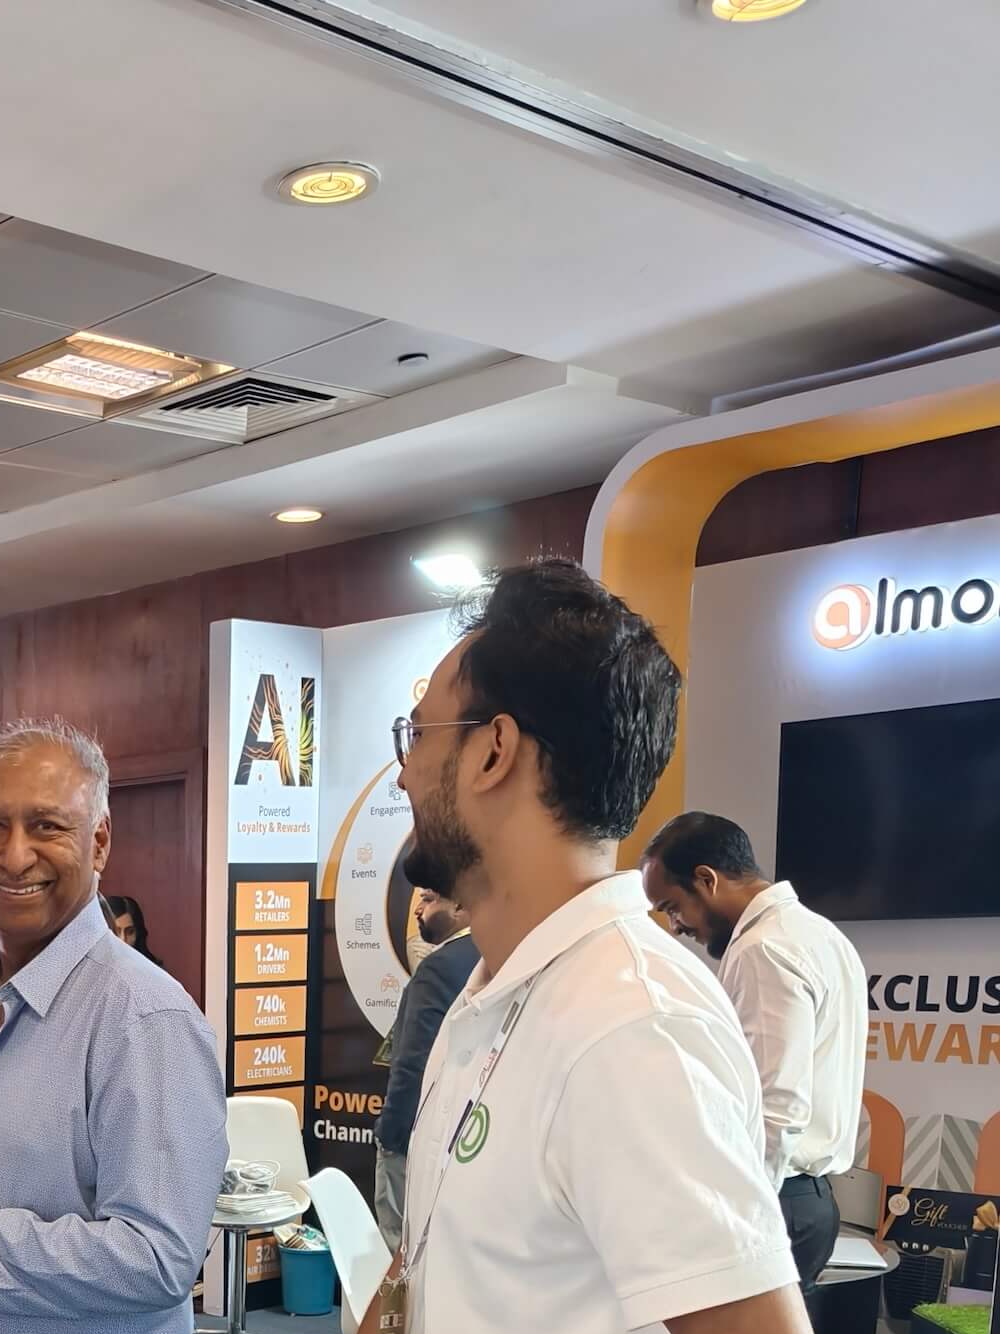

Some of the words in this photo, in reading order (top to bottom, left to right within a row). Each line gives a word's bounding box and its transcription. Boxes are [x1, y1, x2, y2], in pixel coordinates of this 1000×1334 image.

[811, 577, 1000, 651] almo
[234, 674, 316, 787] AI
[258, 805, 291, 818] Powered
[370, 805, 411, 818] Engageme
[237, 822, 268, 836] Loyalty
[269, 822, 275, 833] &
[276, 821, 311, 834] Rewards
[351, 869, 377, 879] Events
[255, 890, 291, 909] 3.2Mn
[255, 911, 290, 921] RETAILERS
[254, 943, 290, 962] 1.2Mn
[346, 939, 381, 950] Schemes
[257, 963, 286, 975] DRIVERS
[256, 994, 287, 1014] 740k
[254, 1015, 287, 1026] CHEMISTS
[866, 1022, 1000, 1065] EWAR
[254, 1045, 286, 1066] 240k
[247, 1066, 293, 1079] ELECTRICIANS
[314, 1085, 384, 1115] Powe
[313, 1119, 375, 1145] Chann
[911, 1198, 948, 1227] Gift
